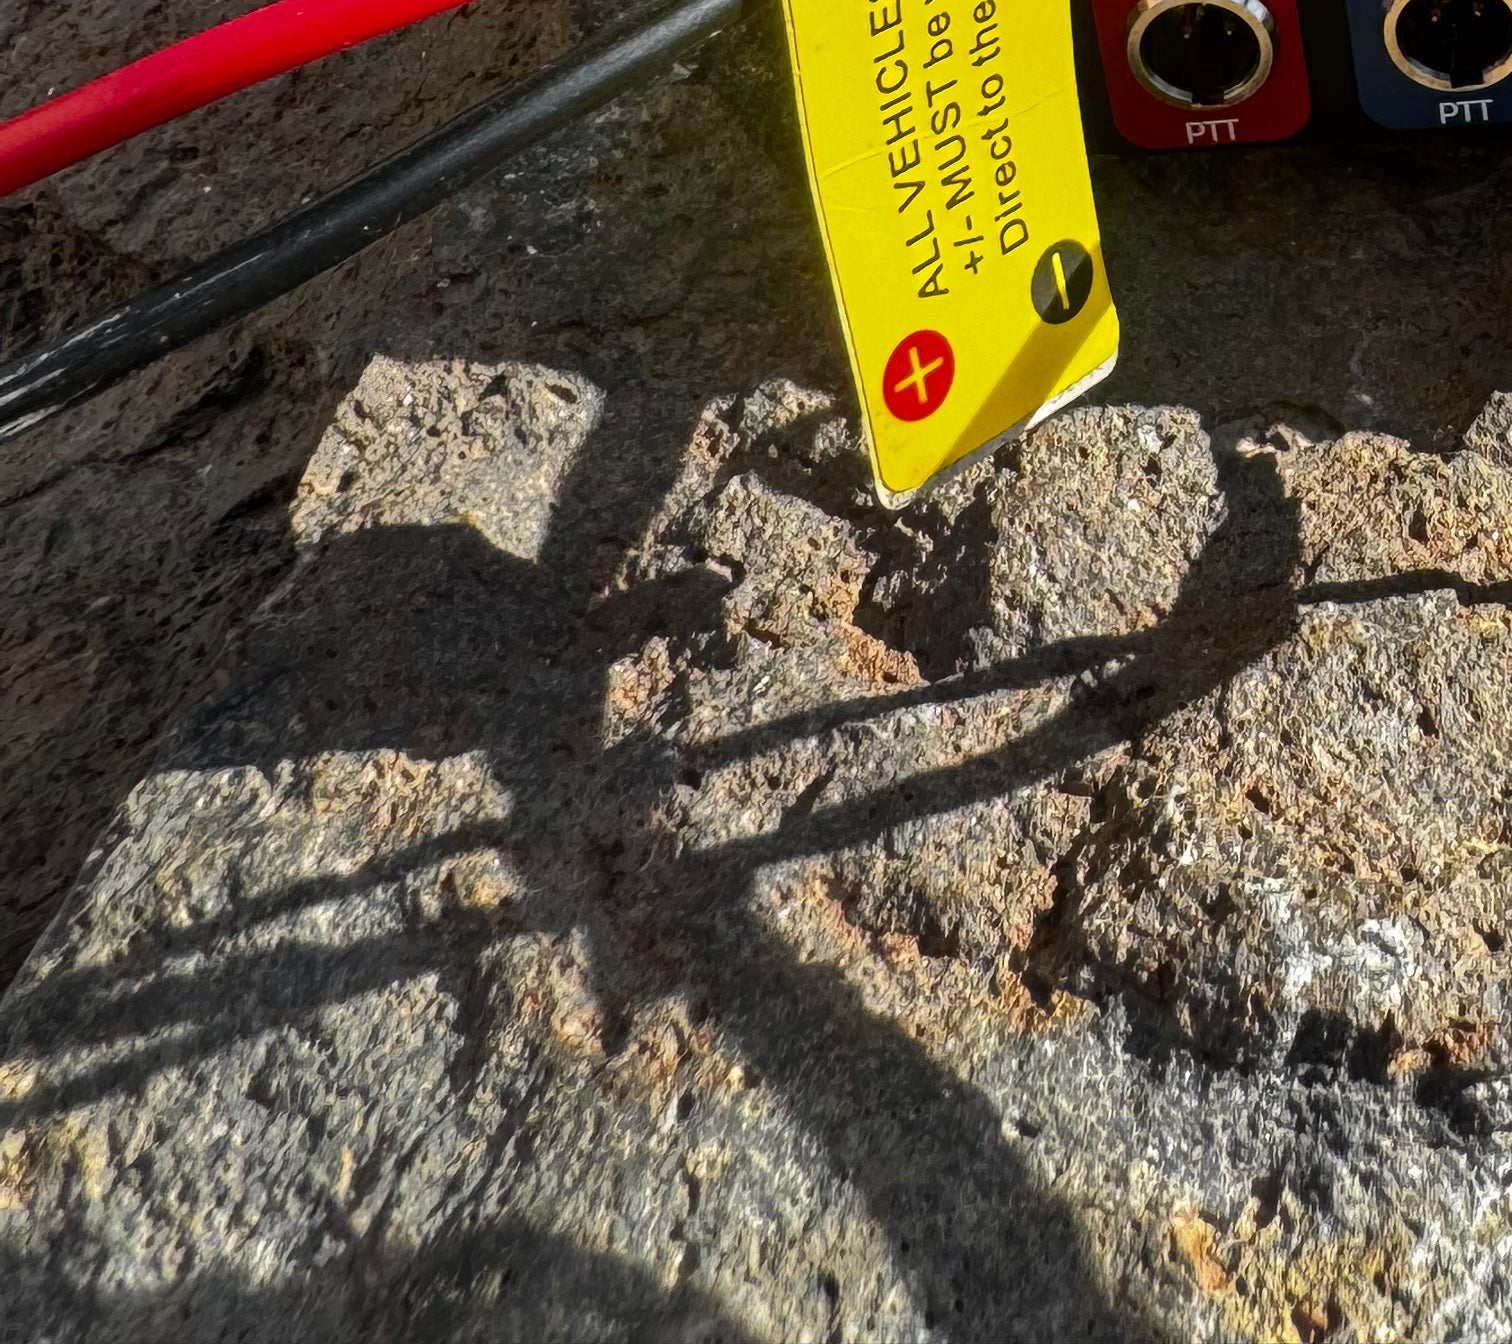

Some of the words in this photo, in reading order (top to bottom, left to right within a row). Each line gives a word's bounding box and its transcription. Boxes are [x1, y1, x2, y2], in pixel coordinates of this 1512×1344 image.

[923, 11, 954, 69] be
[977, 73, 1005, 116] to
[1438, 99, 1493, 124] PTT
[926, 79, 975, 210] MUST
[1185, 118, 1239, 145] PTT
[980, 118, 1029, 255] Direct
[905, 210, 949, 298] ALL
